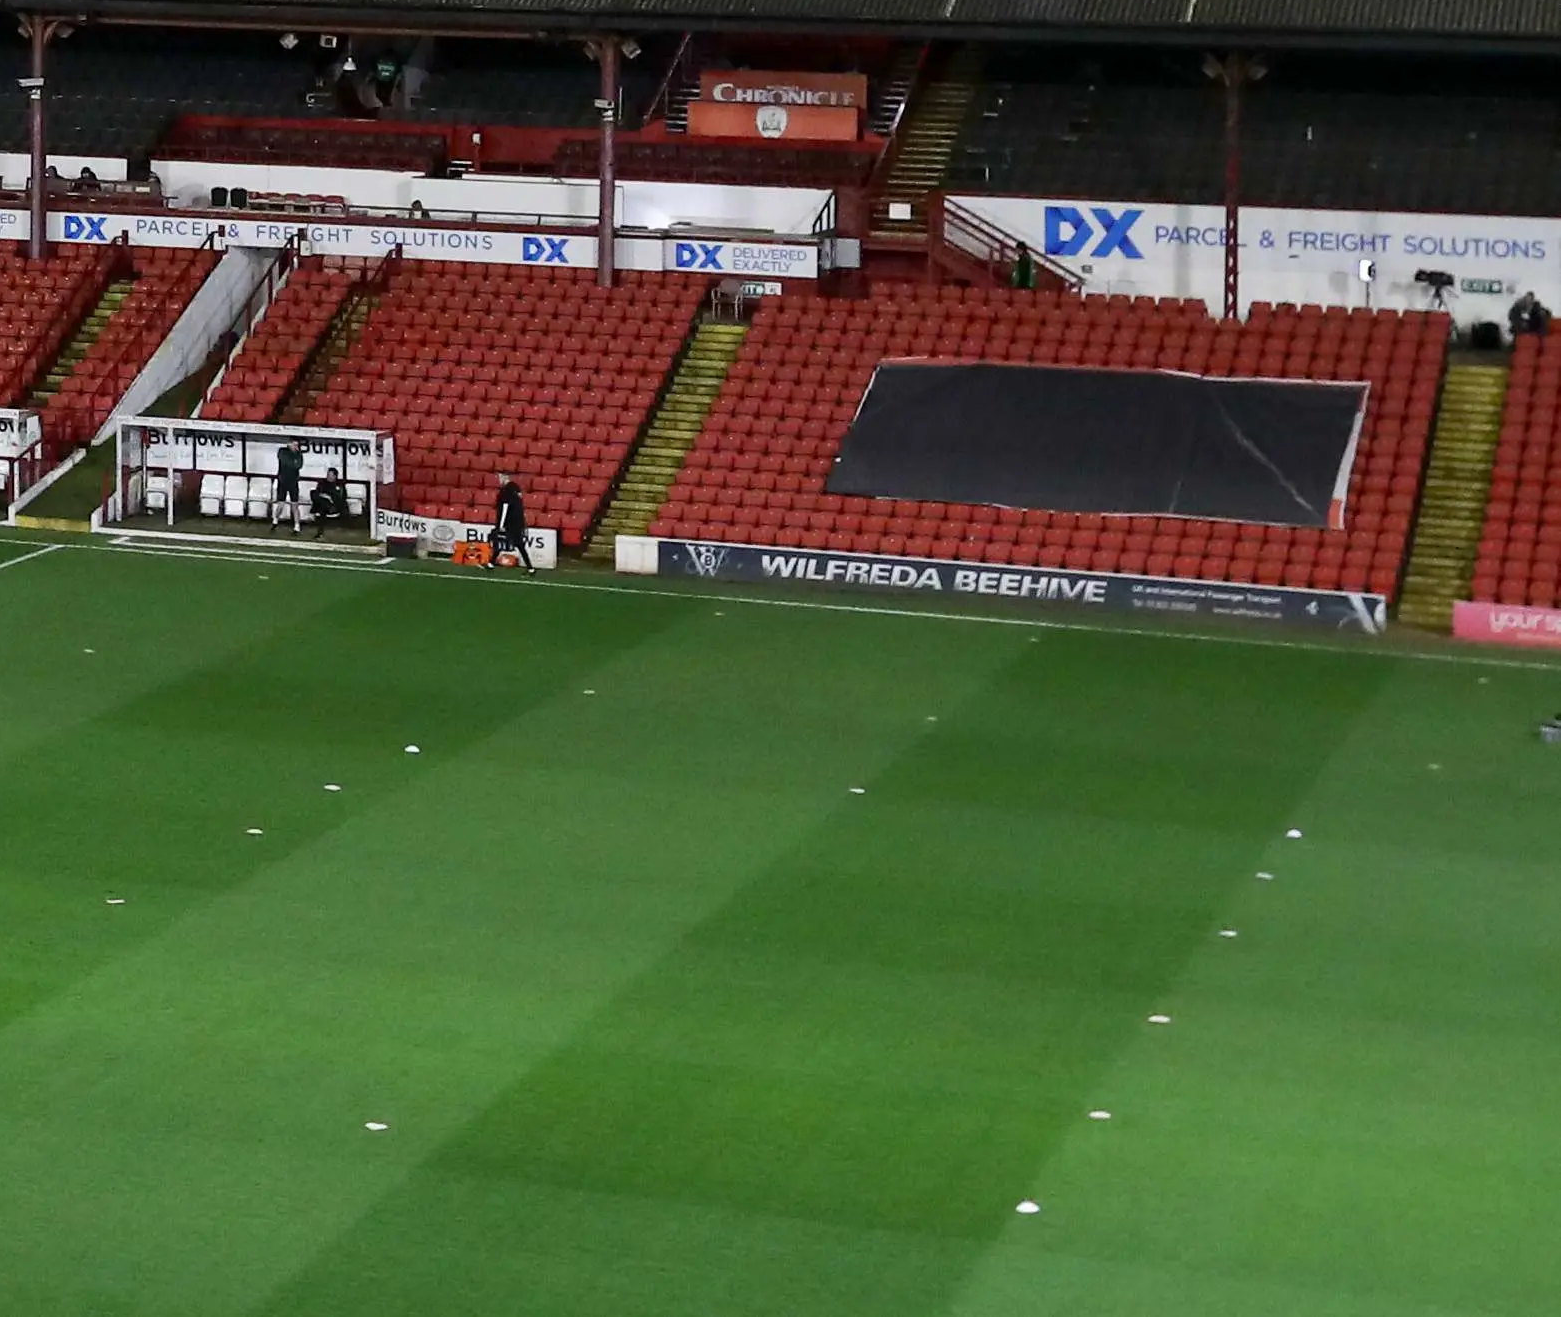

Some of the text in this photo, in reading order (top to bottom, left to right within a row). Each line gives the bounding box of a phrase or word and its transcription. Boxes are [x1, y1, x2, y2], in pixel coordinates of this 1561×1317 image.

[712, 83, 854, 106] CHRONICLE
[63, 215, 108, 241] DX
[229, 223, 240, 238] &
[370, 228, 493, 250] SOLUTIONS
[522, 236, 569, 263] DX
[1044, 206, 1145, 260] DX
[1259, 232, 1275, 248] &
[1287, 231, 1391, 254] FREIGHT
[1403, 235, 1546, 260] SOLUTIONS
[675, 243, 807, 270] DX DELIVERED
[732, 260, 792, 273] EXACTLY
[761, 554, 942, 592] WILFREDA
[953, 569, 1108, 604] BEEHIVE
